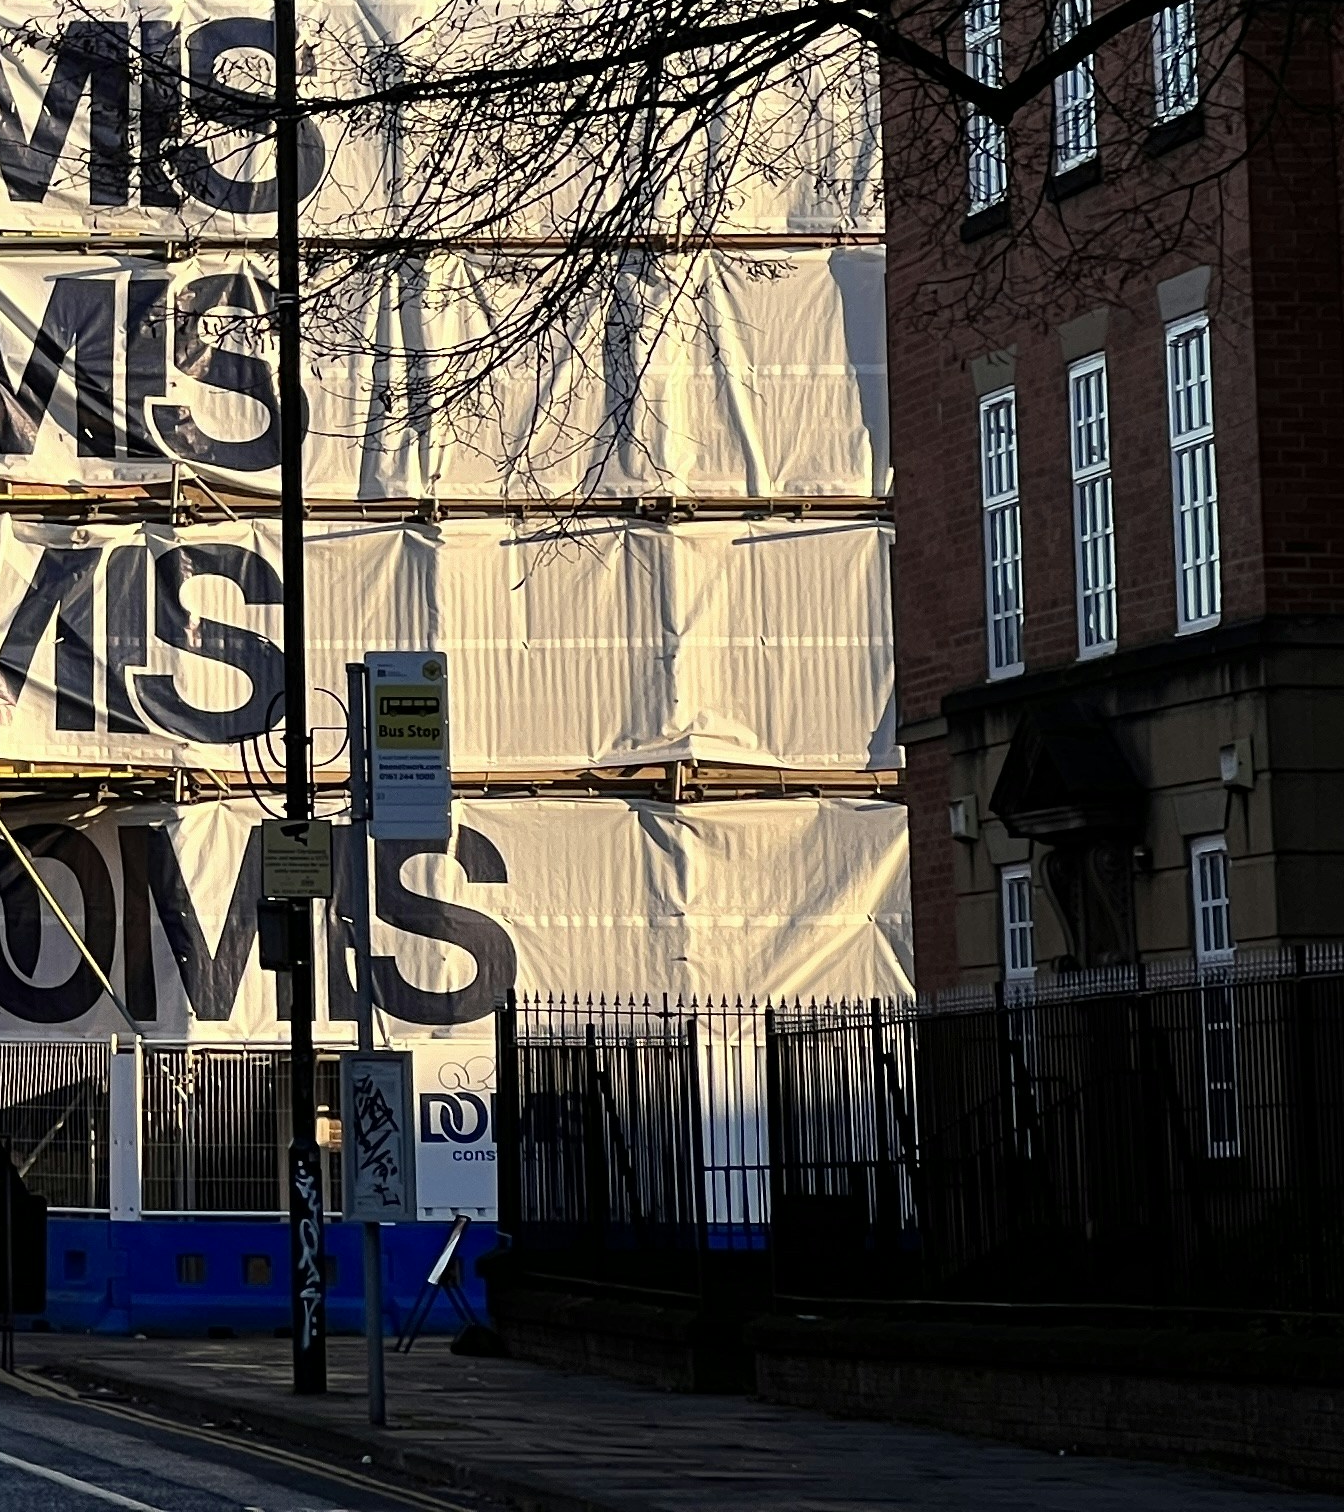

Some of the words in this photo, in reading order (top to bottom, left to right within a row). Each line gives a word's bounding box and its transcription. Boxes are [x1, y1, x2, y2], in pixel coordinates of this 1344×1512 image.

[378, 724, 404, 738] Bus
[408, 724, 441, 741] Stop
[452, 1149, 497, 1162] cons
